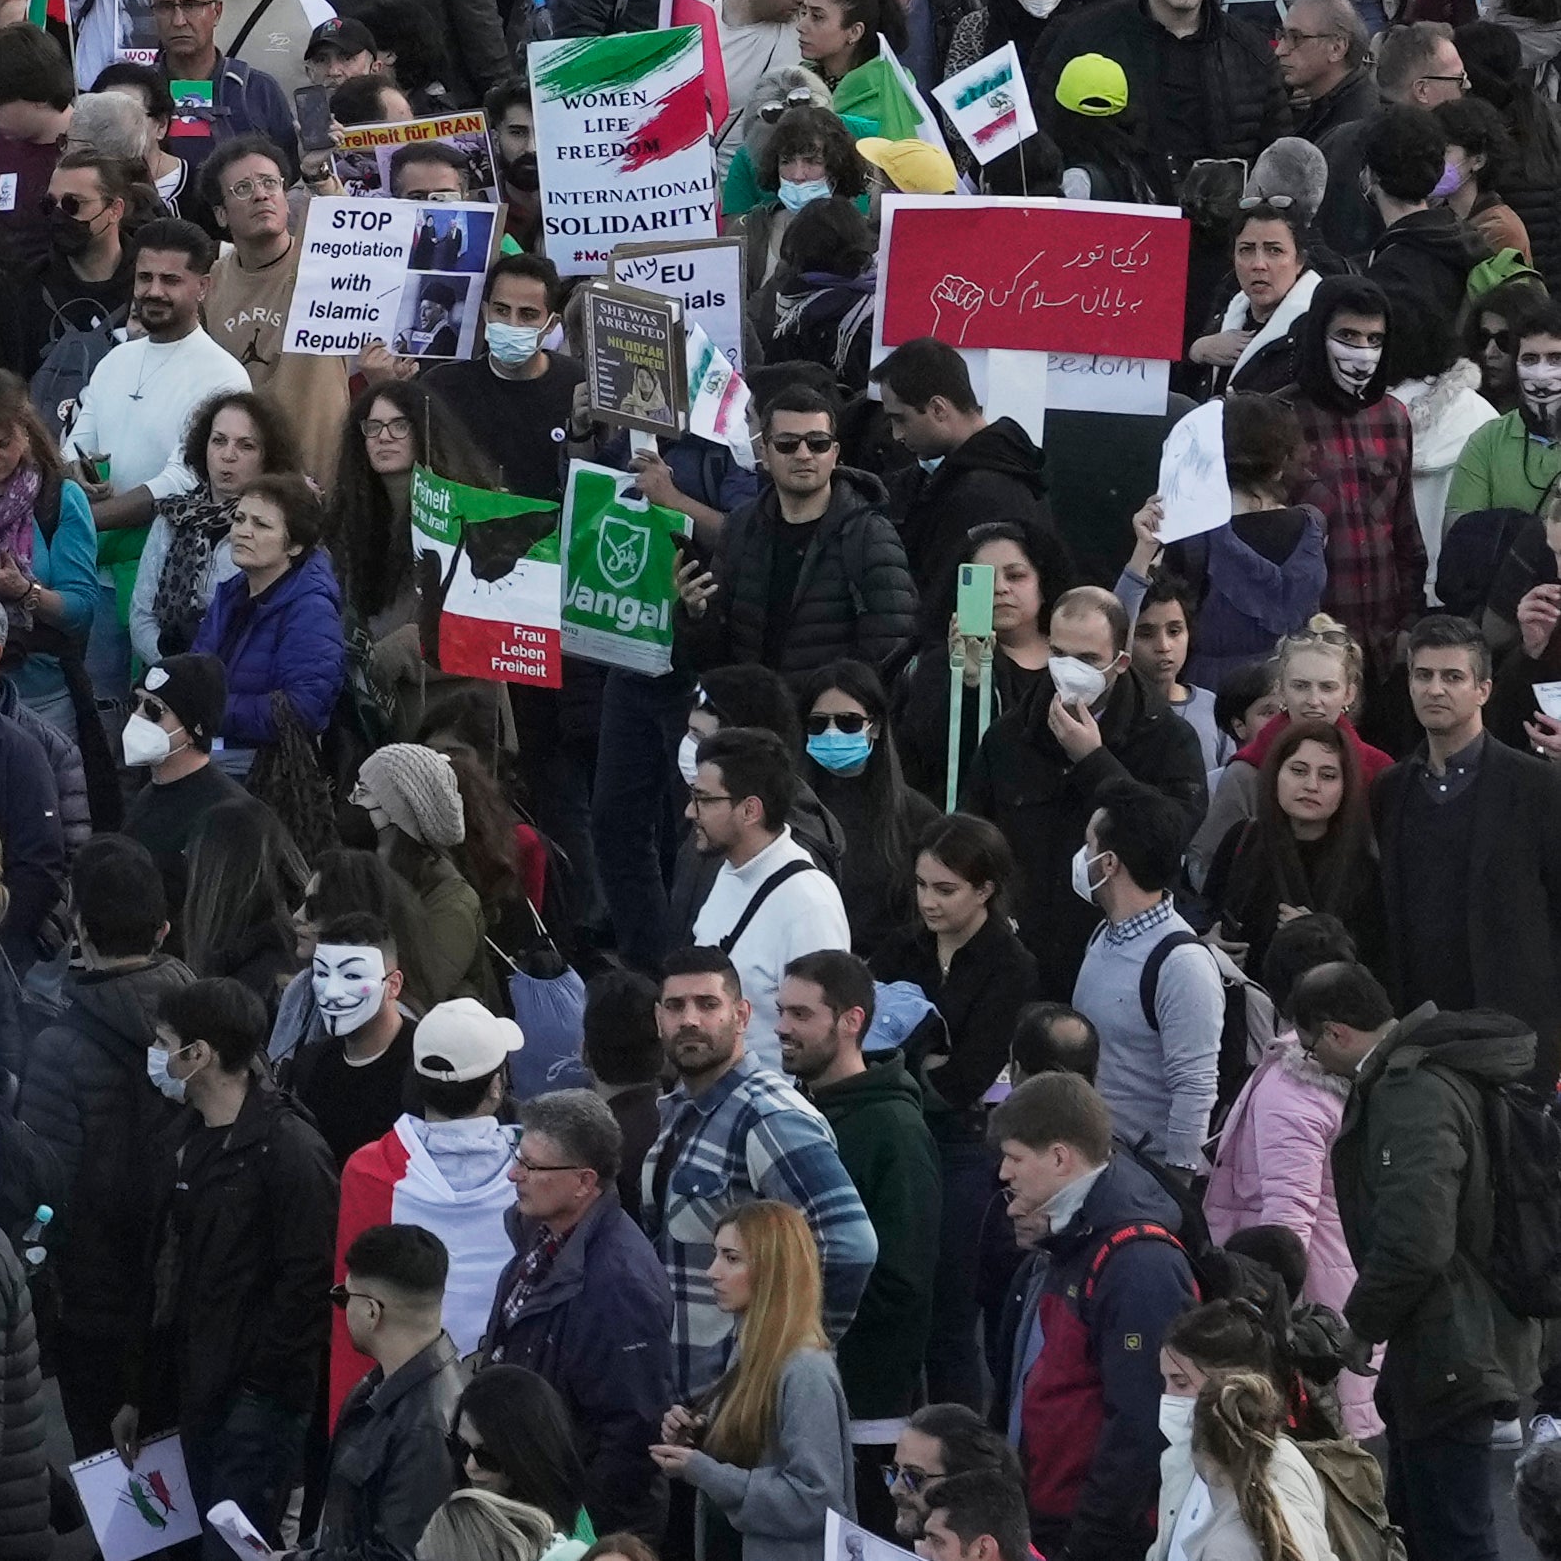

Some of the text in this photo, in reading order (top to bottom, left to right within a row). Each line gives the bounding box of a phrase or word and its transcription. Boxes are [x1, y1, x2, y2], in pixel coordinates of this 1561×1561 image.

[560, 90, 648, 111] WOMEN
[403, 115, 482, 143] für IRAN
[584, 117, 631, 133] LIFE
[556, 139, 660, 161] FREEDOM
[547, 177, 715, 207] INTERNATIONAL
[332, 209, 393, 232] STOP
[545, 202, 715, 237] SOLIDARITY
[309, 240, 404, 261] negotiation
[616, 255, 695, 284] Why EU
[330, 273, 371, 293] with
[308, 299, 380, 322] Islamic
[1019, 281, 1127, 317] پایان سلام
[223, 306, 283, 333] PARIS
[599, 301, 659, 327] SHE WAS
[595, 314, 666, 341] ARRESTED
[566, 574, 671, 632] Jangal
[512, 625, 547, 643] Frau
[501, 643, 547, 662] Leben
[490, 658, 547, 679] Freiheit
